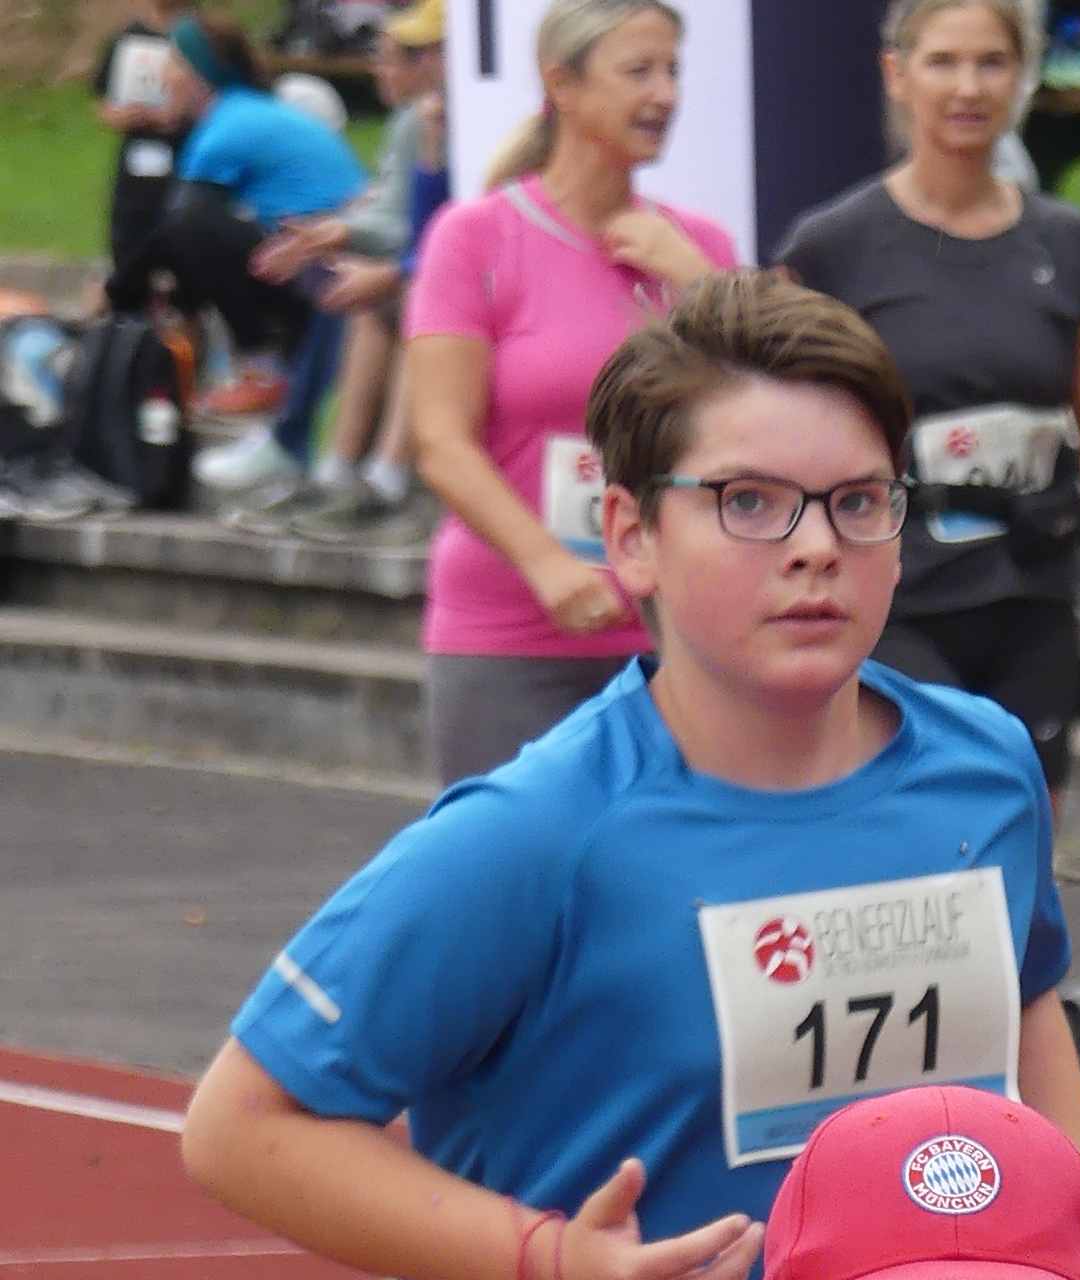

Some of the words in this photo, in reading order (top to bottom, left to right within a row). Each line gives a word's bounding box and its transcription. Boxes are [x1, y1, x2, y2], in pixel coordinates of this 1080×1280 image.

[793, 983, 940, 1090] 171
[911, 1153, 929, 1172] FC
[927, 1140, 993, 1171] BAYERN
